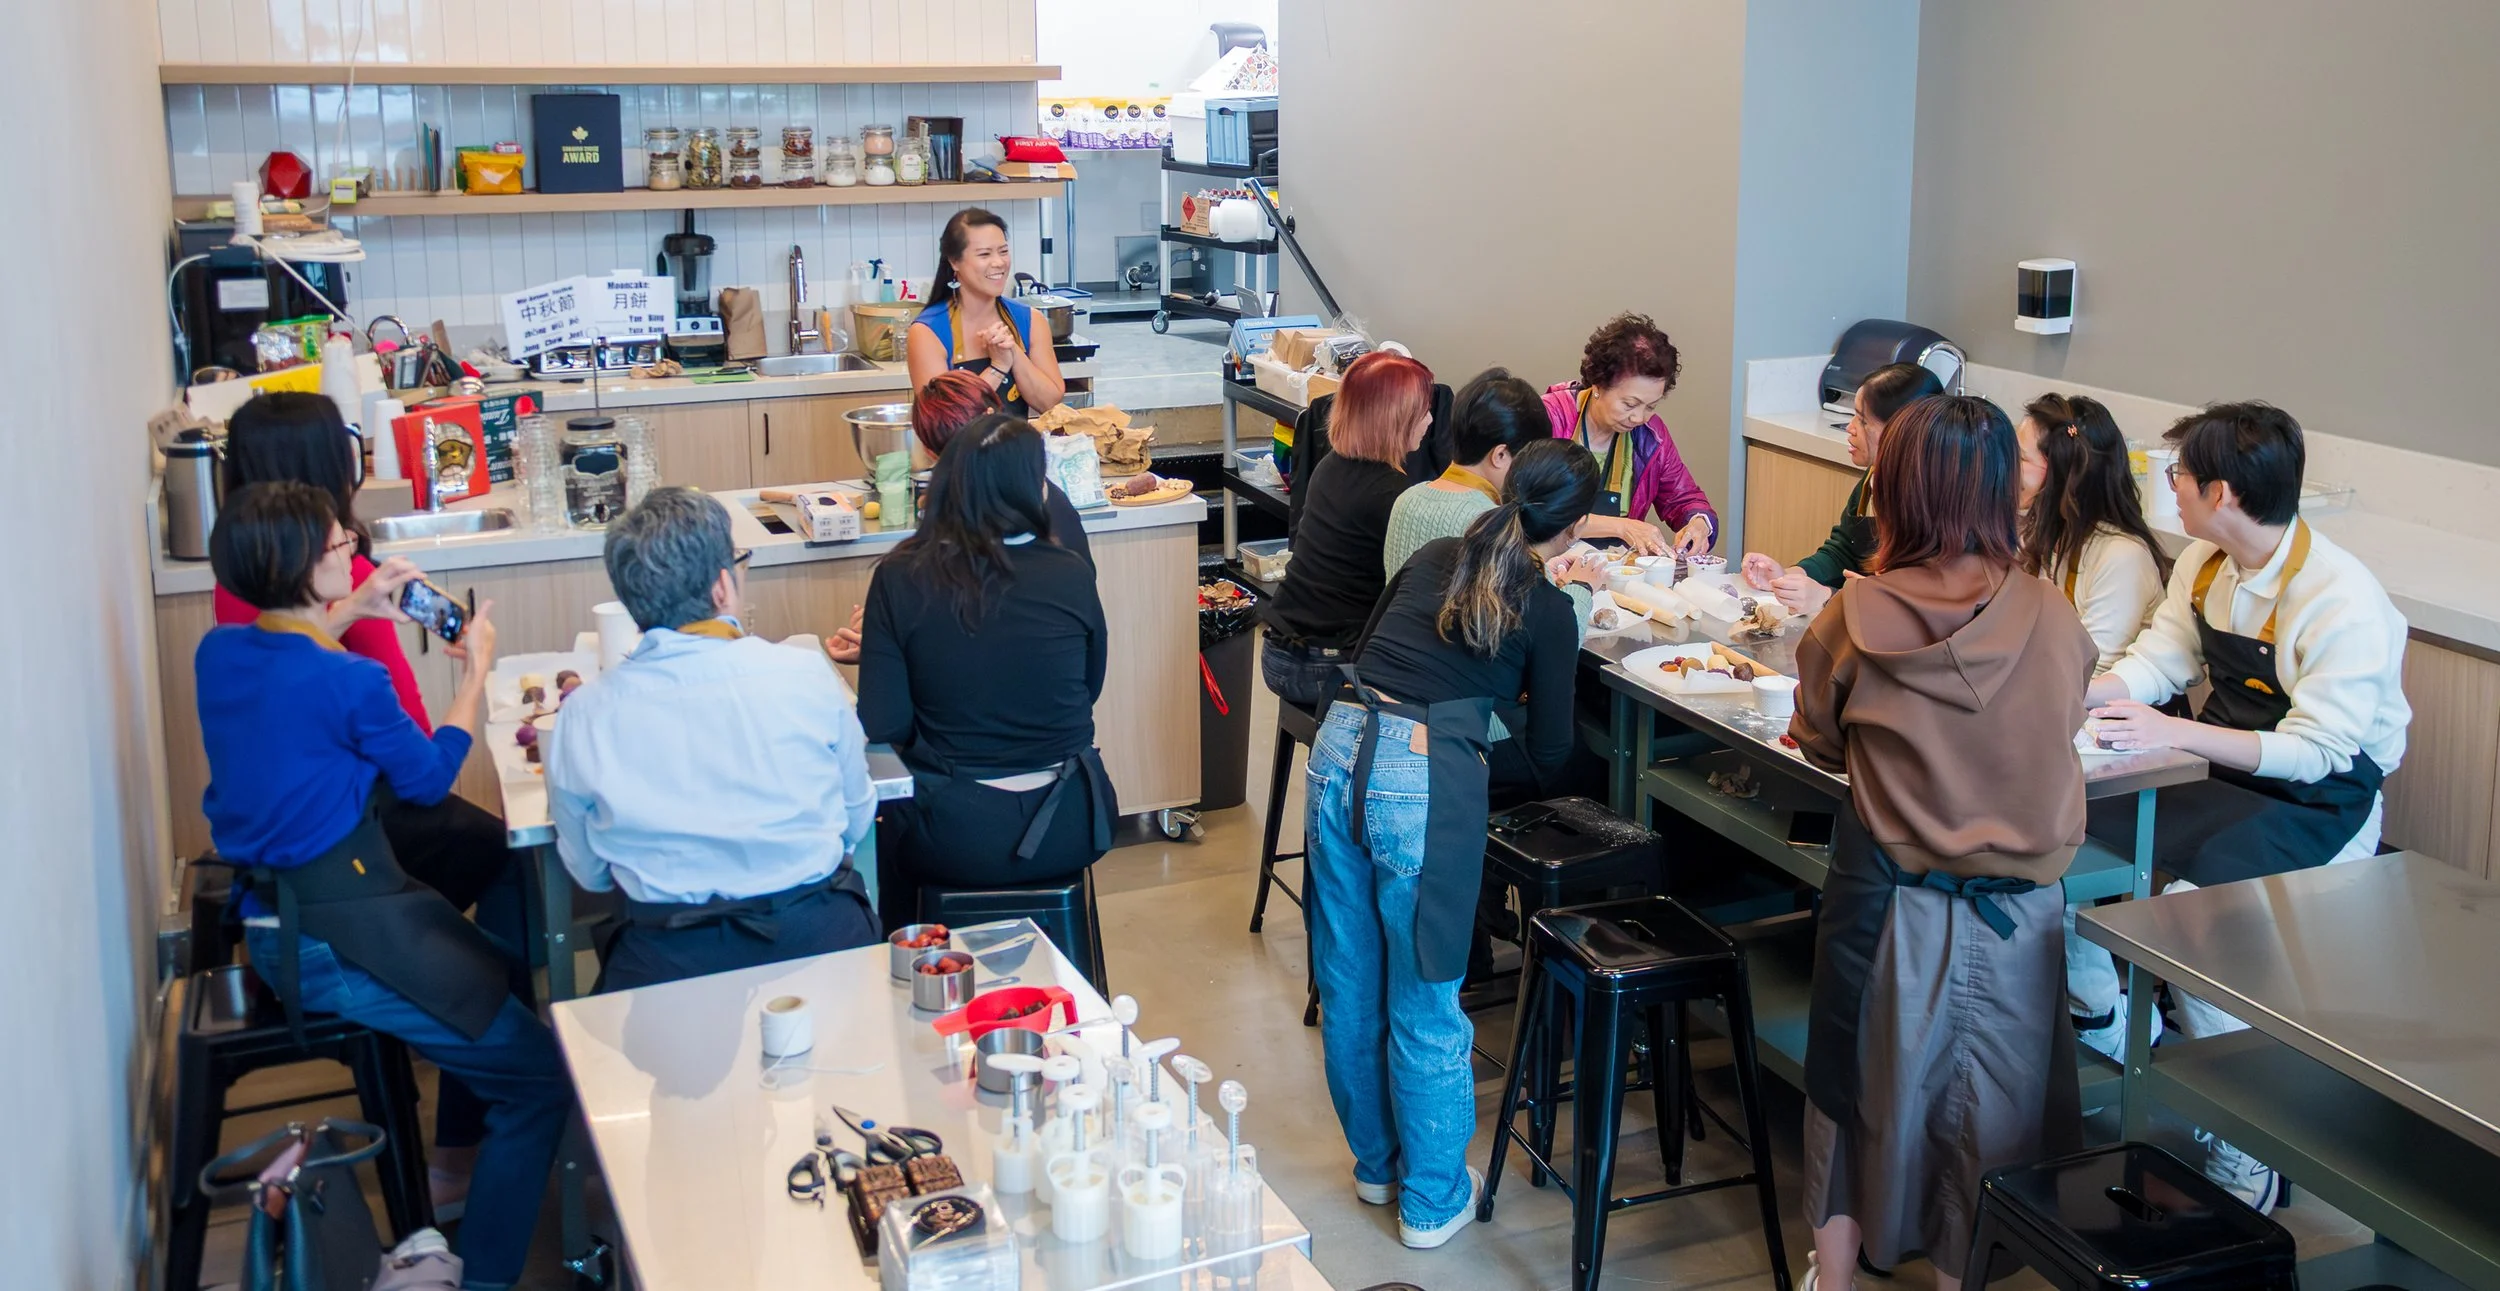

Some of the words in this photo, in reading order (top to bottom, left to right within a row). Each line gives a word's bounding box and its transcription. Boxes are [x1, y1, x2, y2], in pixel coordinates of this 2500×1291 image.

[562, 152, 600, 163] AWARD
[520, 294, 575, 322] 中秋節
[613, 292, 648, 309] 月餅
